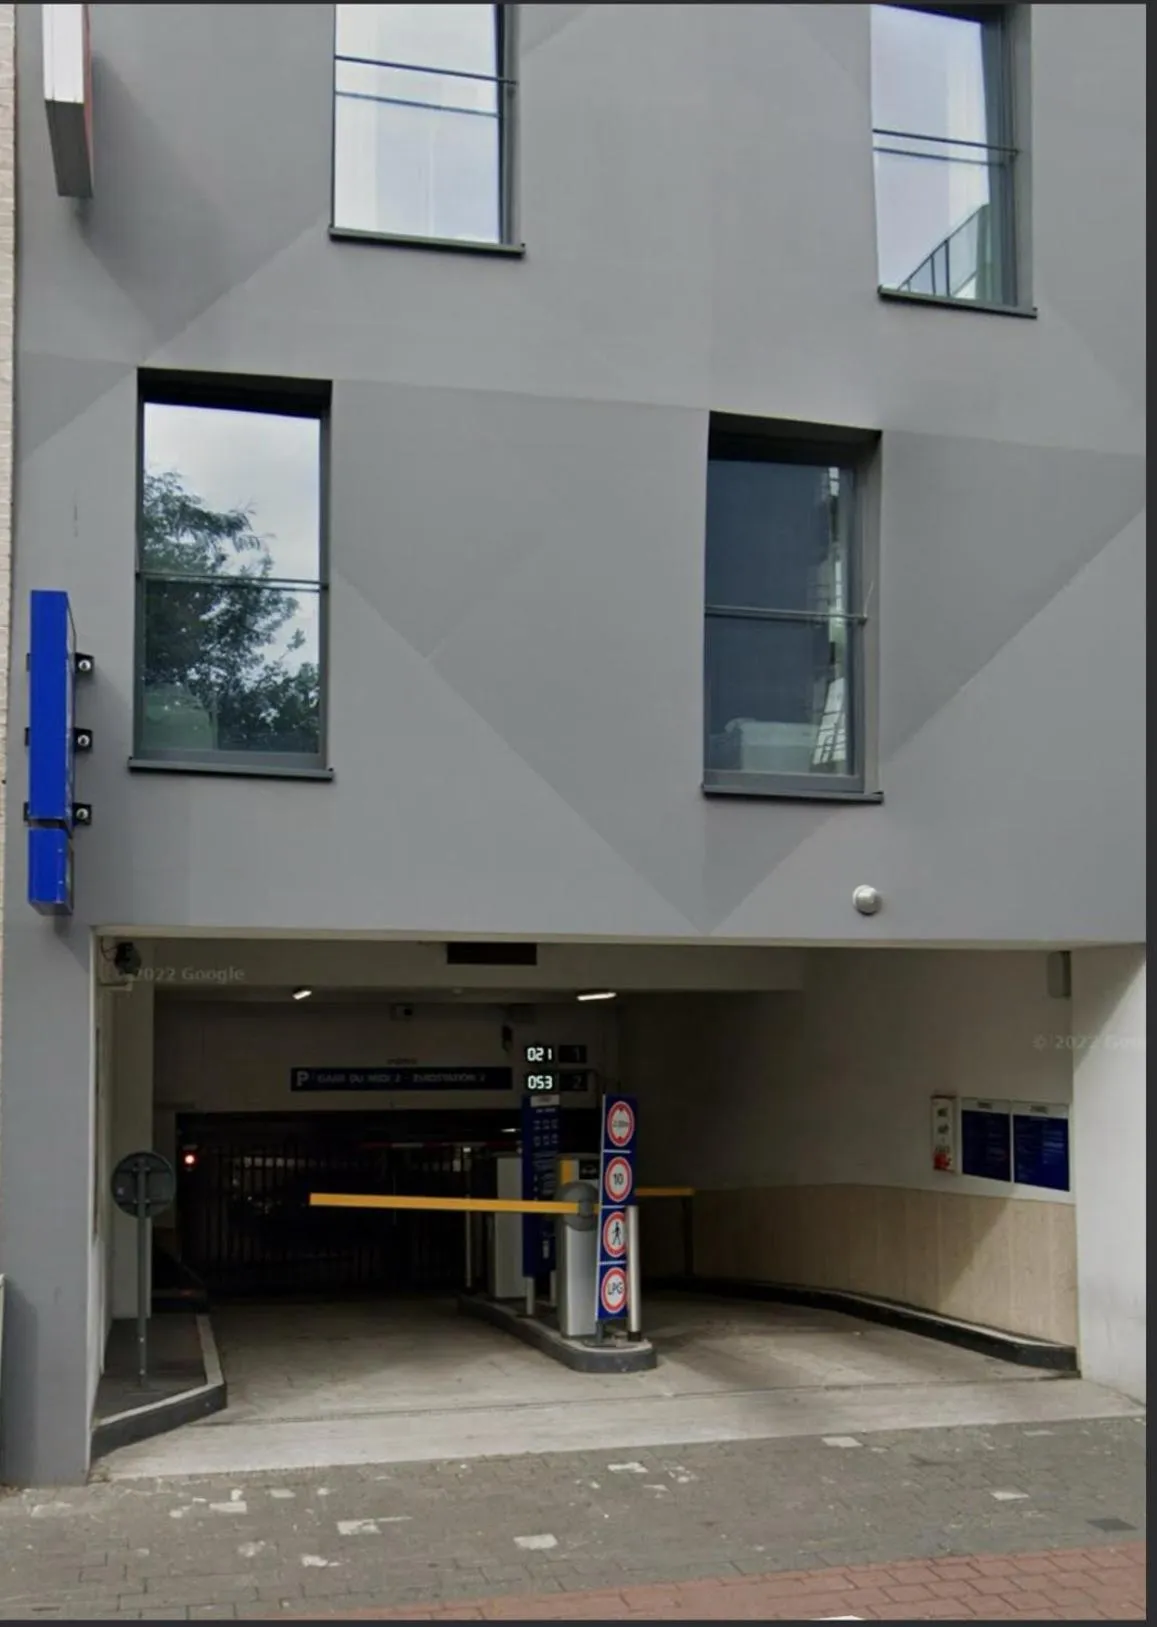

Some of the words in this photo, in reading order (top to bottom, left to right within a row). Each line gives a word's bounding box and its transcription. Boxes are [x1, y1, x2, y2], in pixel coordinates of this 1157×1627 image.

[527, 1047, 552, 1061] 021
[296, 1070, 310, 1087] P
[528, 1075, 553, 1089] 053
[613, 1173, 624, 1185] 10
[608, 1282, 623, 1295] LPG
